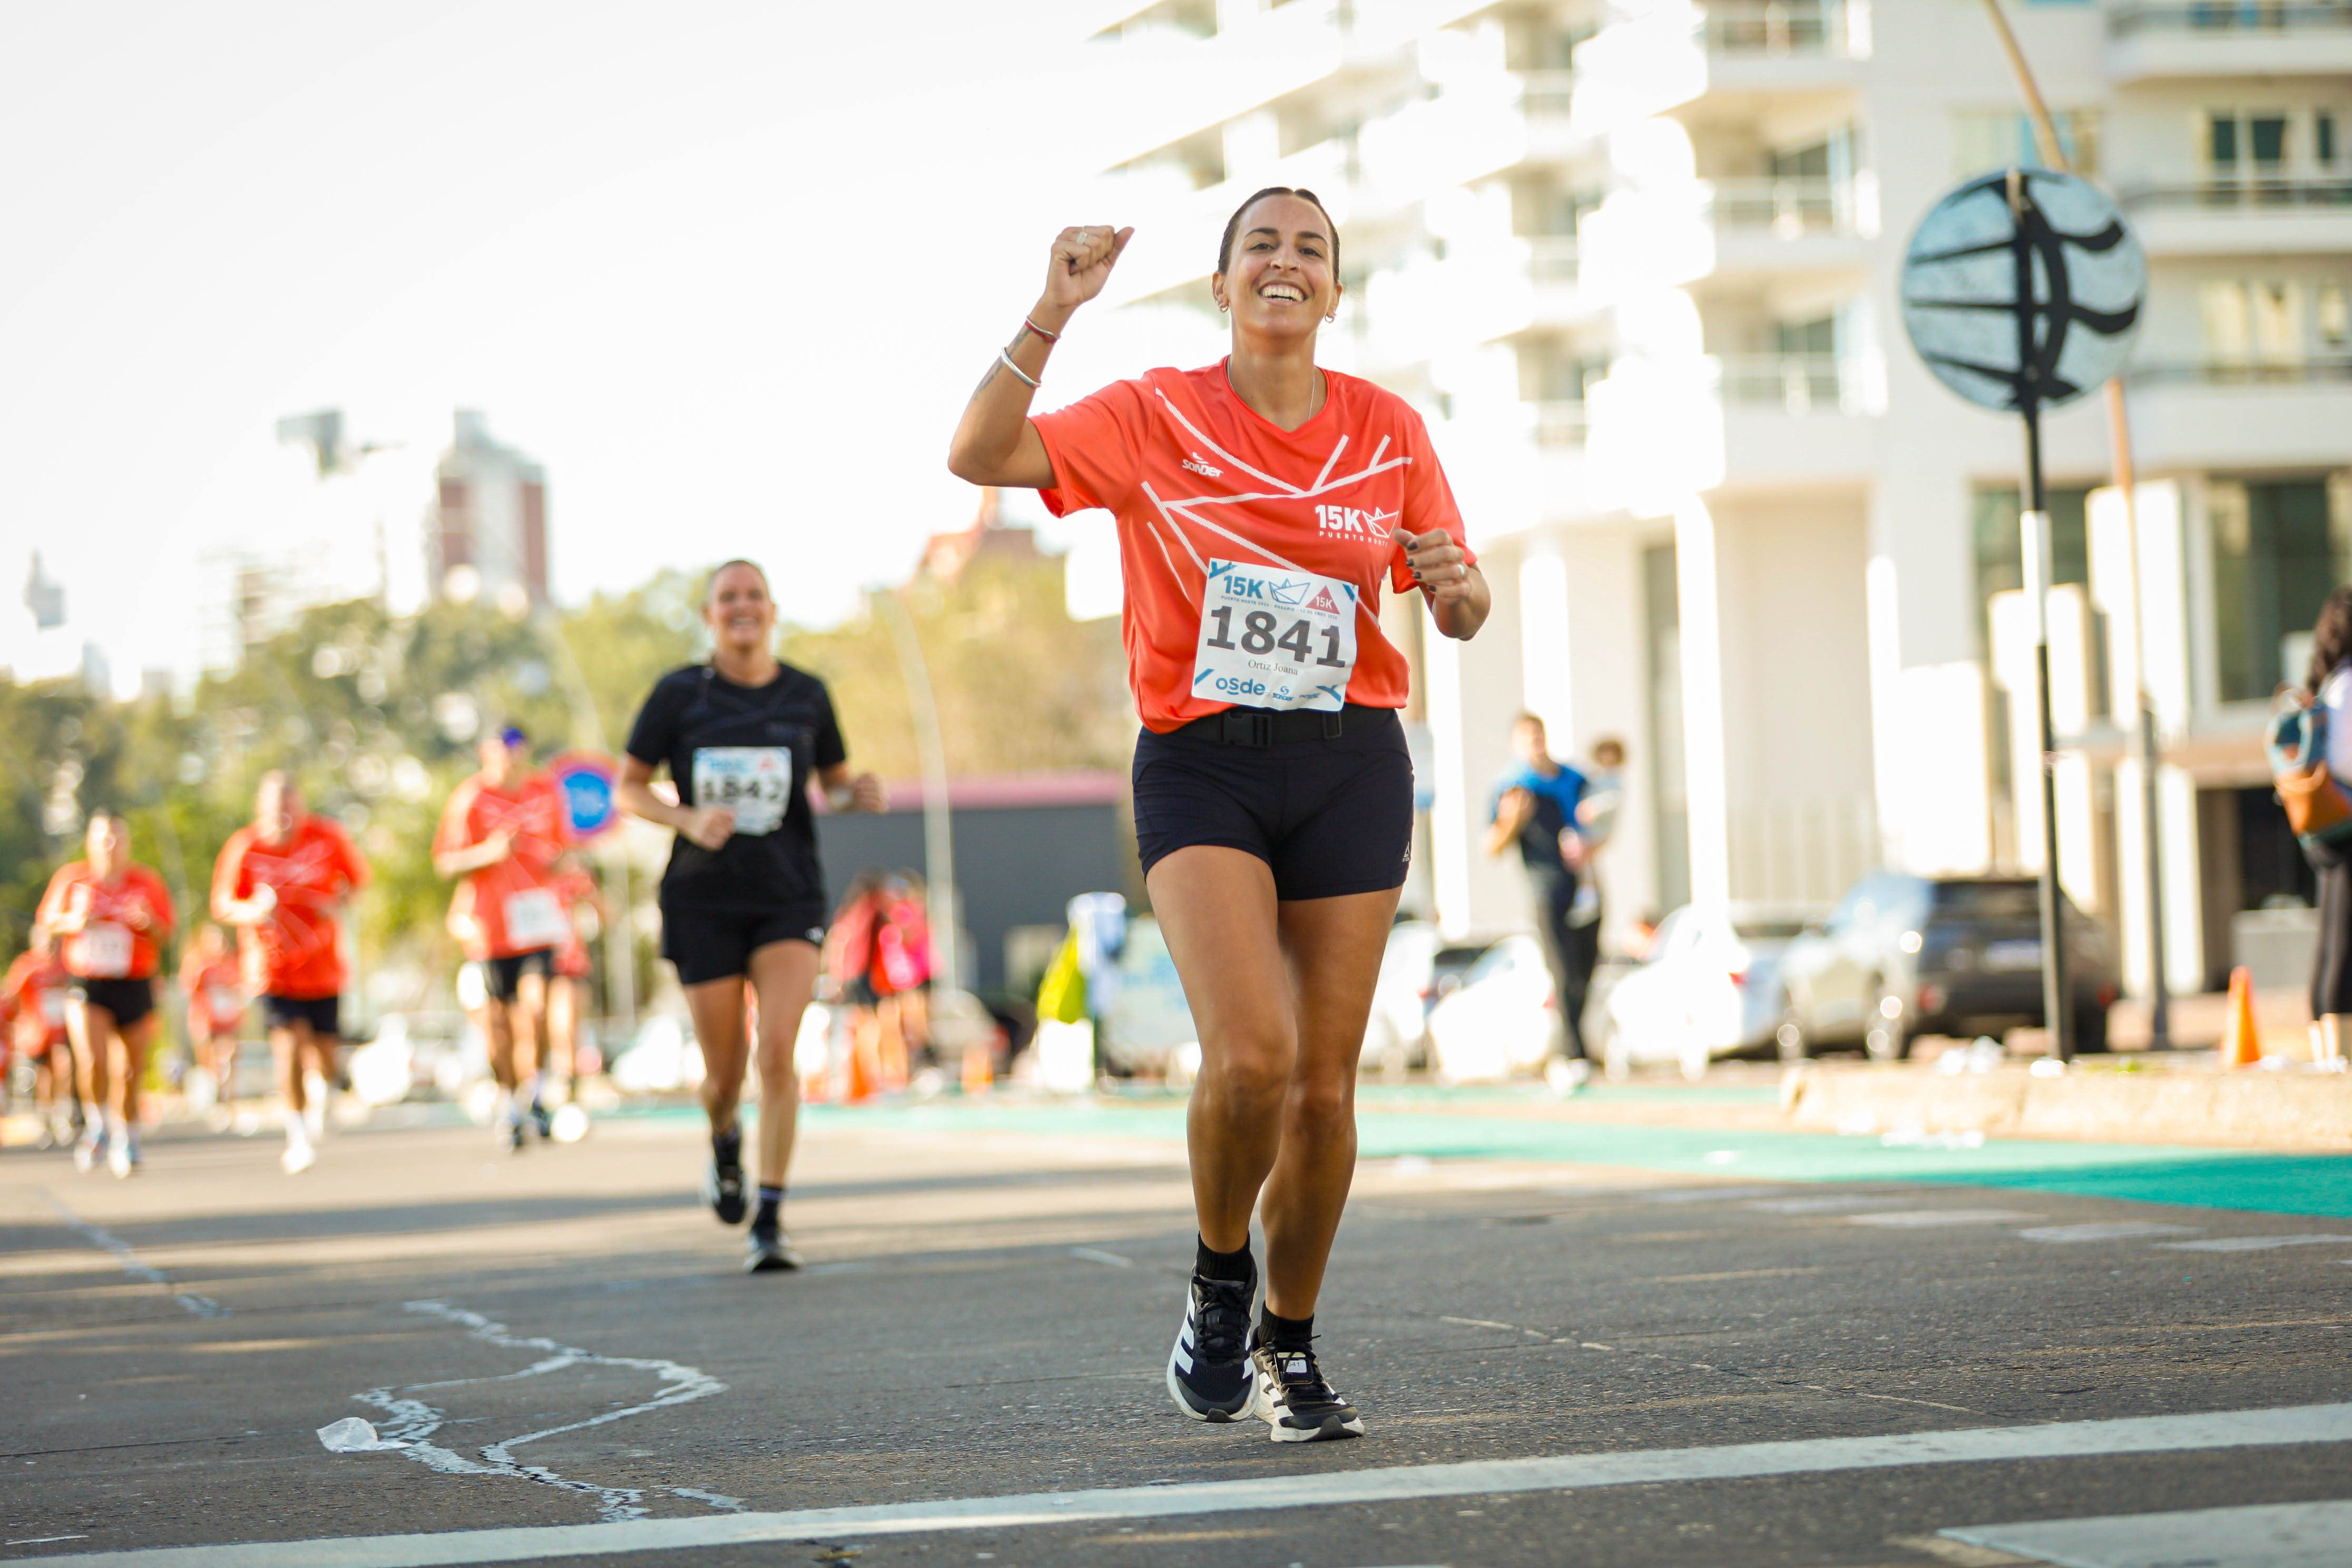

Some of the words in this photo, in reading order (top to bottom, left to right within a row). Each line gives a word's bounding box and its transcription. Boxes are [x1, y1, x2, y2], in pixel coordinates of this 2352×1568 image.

[1315, 505, 1364, 533] 15K
[1319, 531, 1364, 541] PUERTO
[1223, 575, 1265, 599] 15K
[1316, 596, 1333, 610] 15K
[1207, 605, 1346, 668] 1841
[1248, 659, 1271, 671] Ortiz
[1273, 663, 1298, 676] Joana
[1216, 678, 1266, 695] osde
